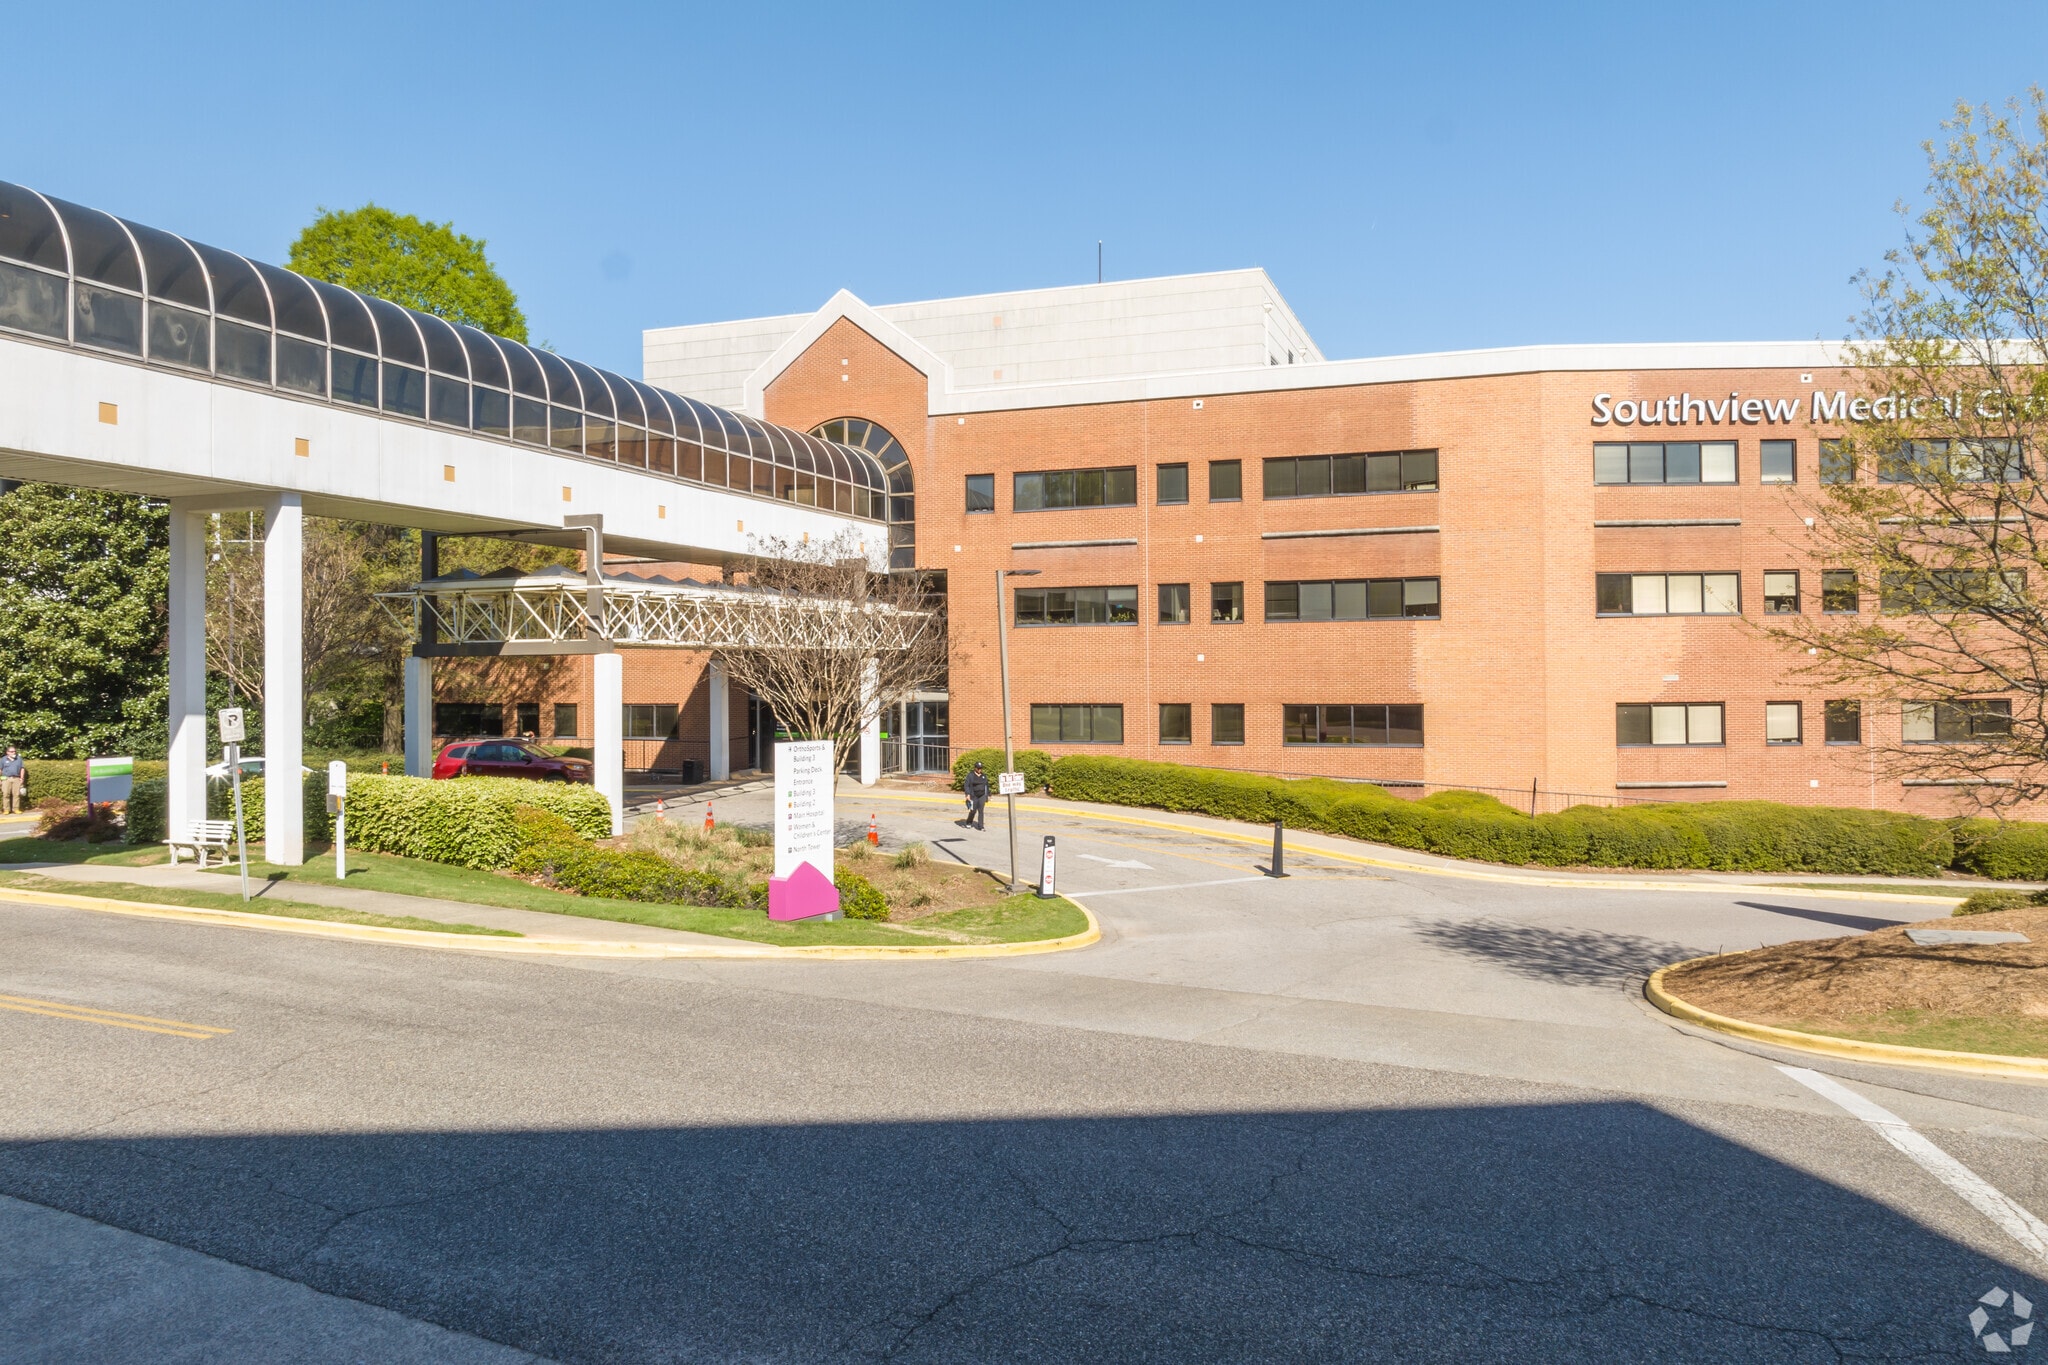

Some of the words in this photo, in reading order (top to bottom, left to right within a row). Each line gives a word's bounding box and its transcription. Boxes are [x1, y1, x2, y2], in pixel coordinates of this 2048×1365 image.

[1591, 392, 1801, 425] Southview
[1811, 389, 1963, 421] Medical
[793, 745, 821, 753] OrthoSports
[793, 755, 811, 763] Building
[793, 767, 811, 775] Parking
